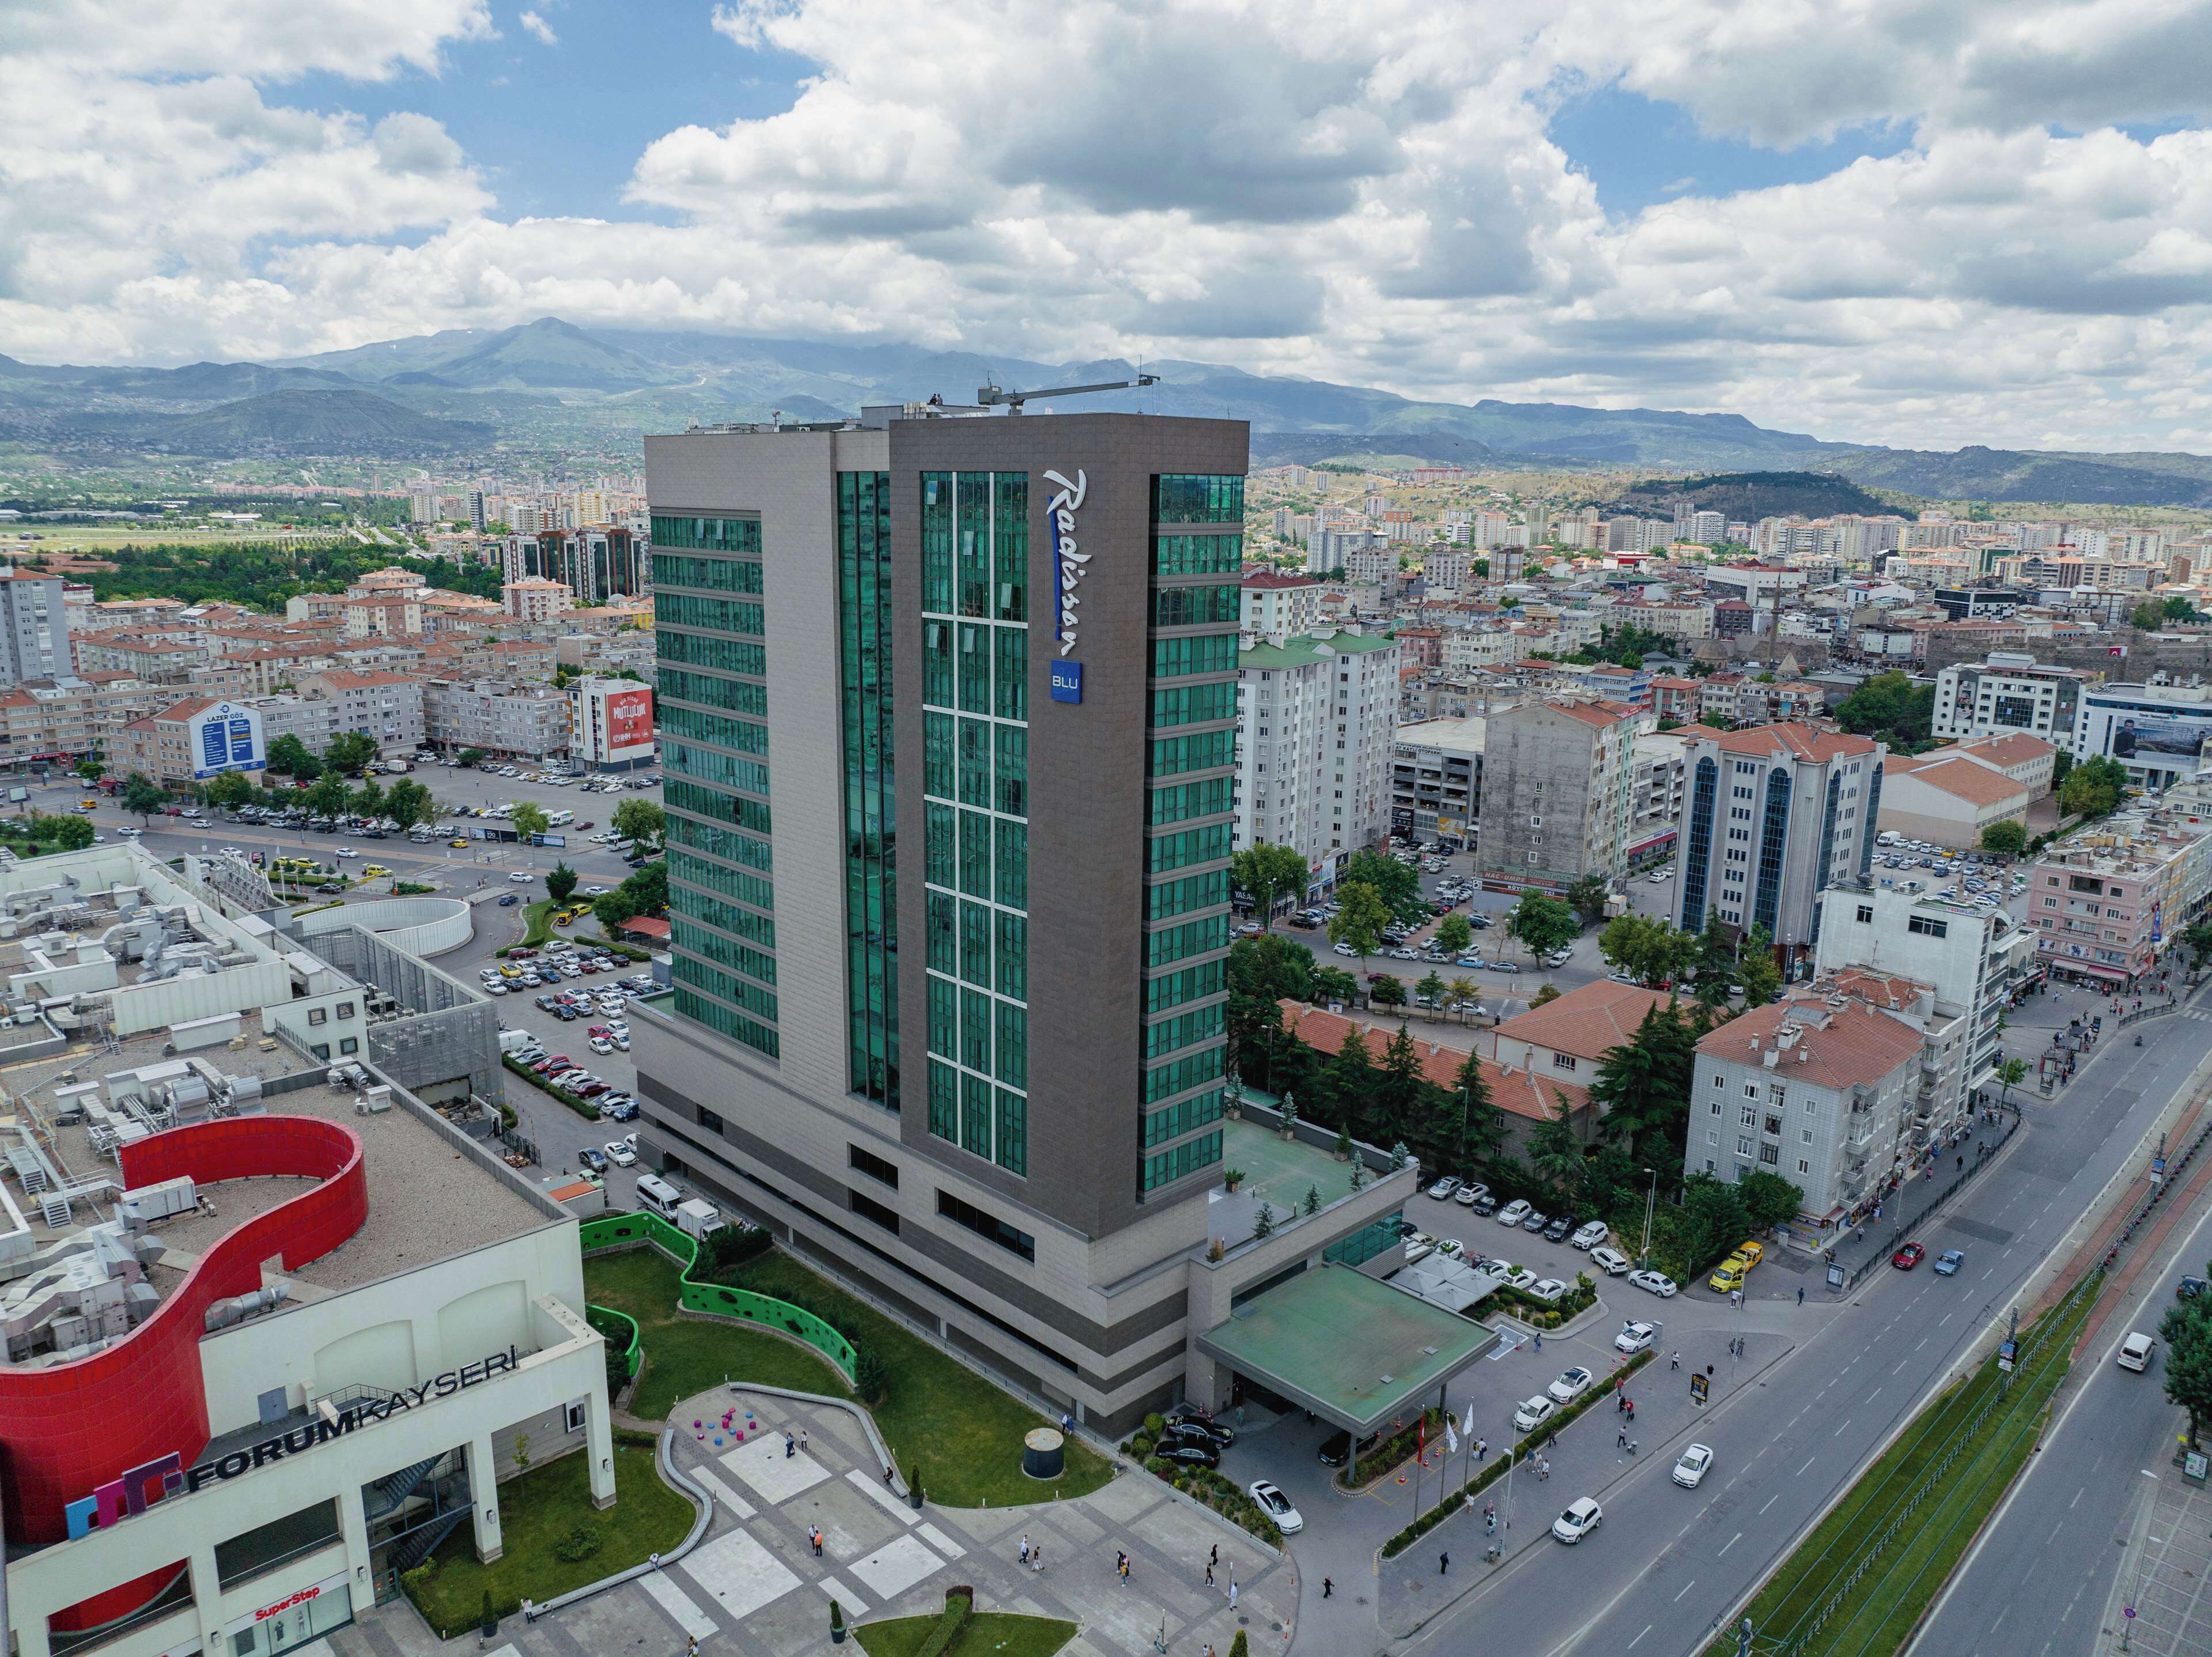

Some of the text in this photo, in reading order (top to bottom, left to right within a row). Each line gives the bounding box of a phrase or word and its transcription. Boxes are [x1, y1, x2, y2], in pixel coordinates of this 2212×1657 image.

[1043, 469, 1092, 656] Radisson
[1053, 675, 1078, 689] BLU
[613, 703, 646, 719] MUTLULUK
[255, 1587, 320, 1621] SuperStep
